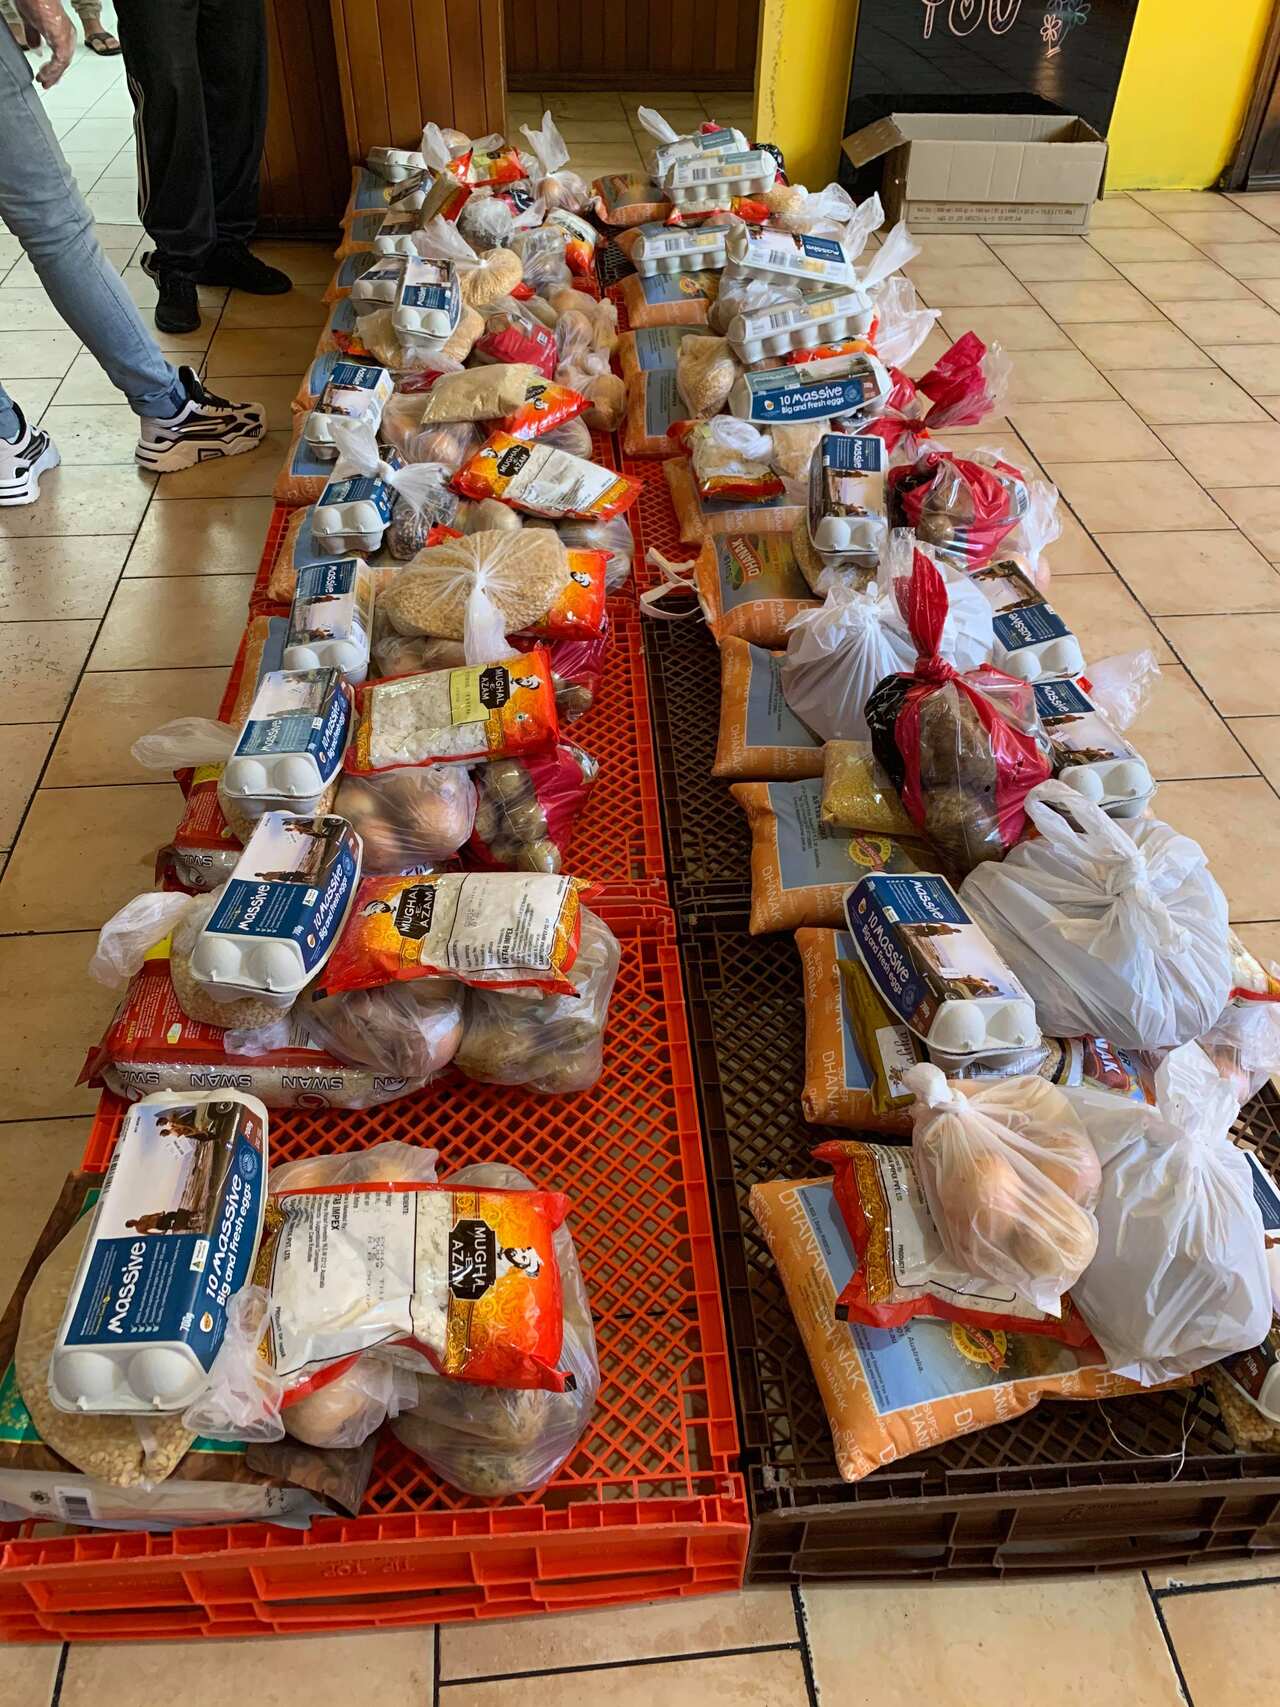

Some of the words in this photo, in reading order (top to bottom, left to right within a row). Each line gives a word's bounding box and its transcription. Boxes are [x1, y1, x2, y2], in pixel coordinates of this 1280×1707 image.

[779, 395, 791, 406] 10
[792, 385, 843, 404] Massive
[781, 406, 793, 414] Big
[793, 402, 807, 412] and
[827, 396, 845, 406] eggs
[732, 537, 760, 577] DHANAK
[481, 677, 490, 701] AZAM
[495, 668, 505, 705] MUGHAL
[238, 884, 271, 931] Massive
[318, 863, 343, 914] Massive
[762, 864, 783, 921] DHANAK
[909, 879, 945, 920] Massive
[420, 890, 433, 928] AZAM
[319, 926, 329, 941] Big
[505, 928, 514, 945] IMPEX
[867, 911, 879, 928] 10
[873, 925, 911, 983] Massive
[190, 1073, 252, 1087] SWAN
[281, 1075, 344, 1090] SWAN
[822, 1051, 841, 1120] DHANAK
[240, 1182, 252, 1217] eggs
[331, 1207, 341, 1231] IMPEX
[206, 1274, 219, 1298] 10
[213, 1174, 242, 1276] Massive
[230, 1217, 245, 1253] Fresh
[778, 1188, 829, 1283] DHANAK
[225, 1252, 236, 1282] and
[472, 1226, 487, 1293] MUGHAL
[107, 1241, 147, 1335] Massive
[216, 1282, 231, 1307] Big
[814, 1305, 864, 1391] DHANAK
[820, 1358, 849, 1412] DHANAK
[843, 1429, 871, 1473] SUPER
